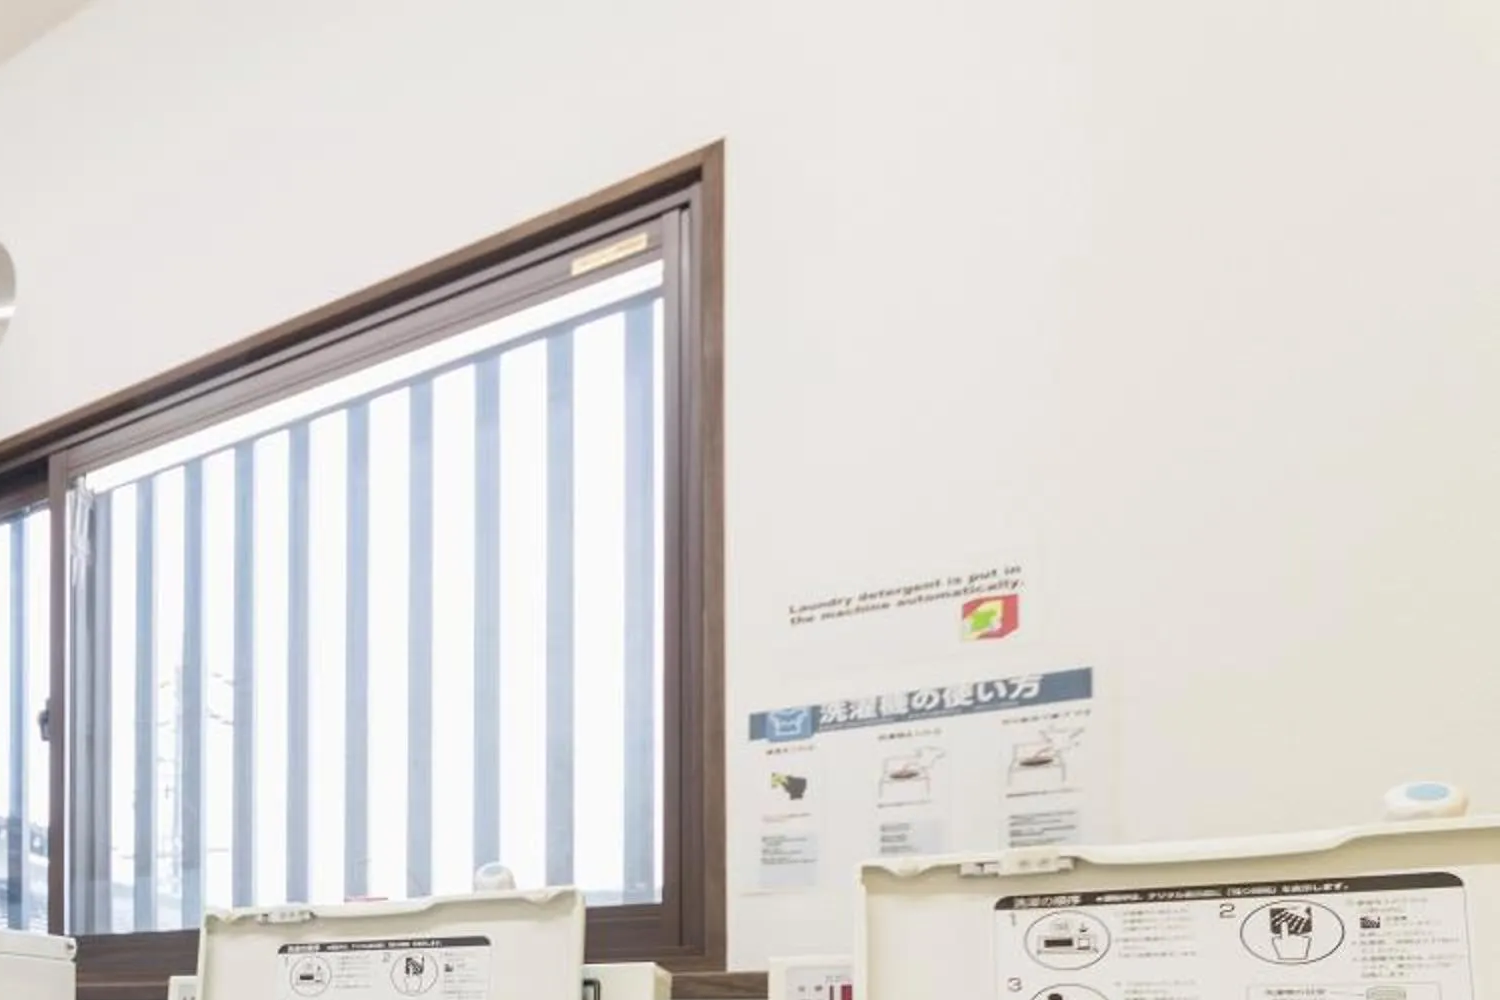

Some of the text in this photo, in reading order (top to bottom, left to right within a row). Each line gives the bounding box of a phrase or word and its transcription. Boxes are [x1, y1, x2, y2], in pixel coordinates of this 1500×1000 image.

[788, 565, 1022, 615] Laundry detergent is put in
[790, 614, 814, 626] the
[821, 601, 891, 622] machine
[1219, 903, 1236, 919] 2
[1007, 976, 1023, 993] 3
